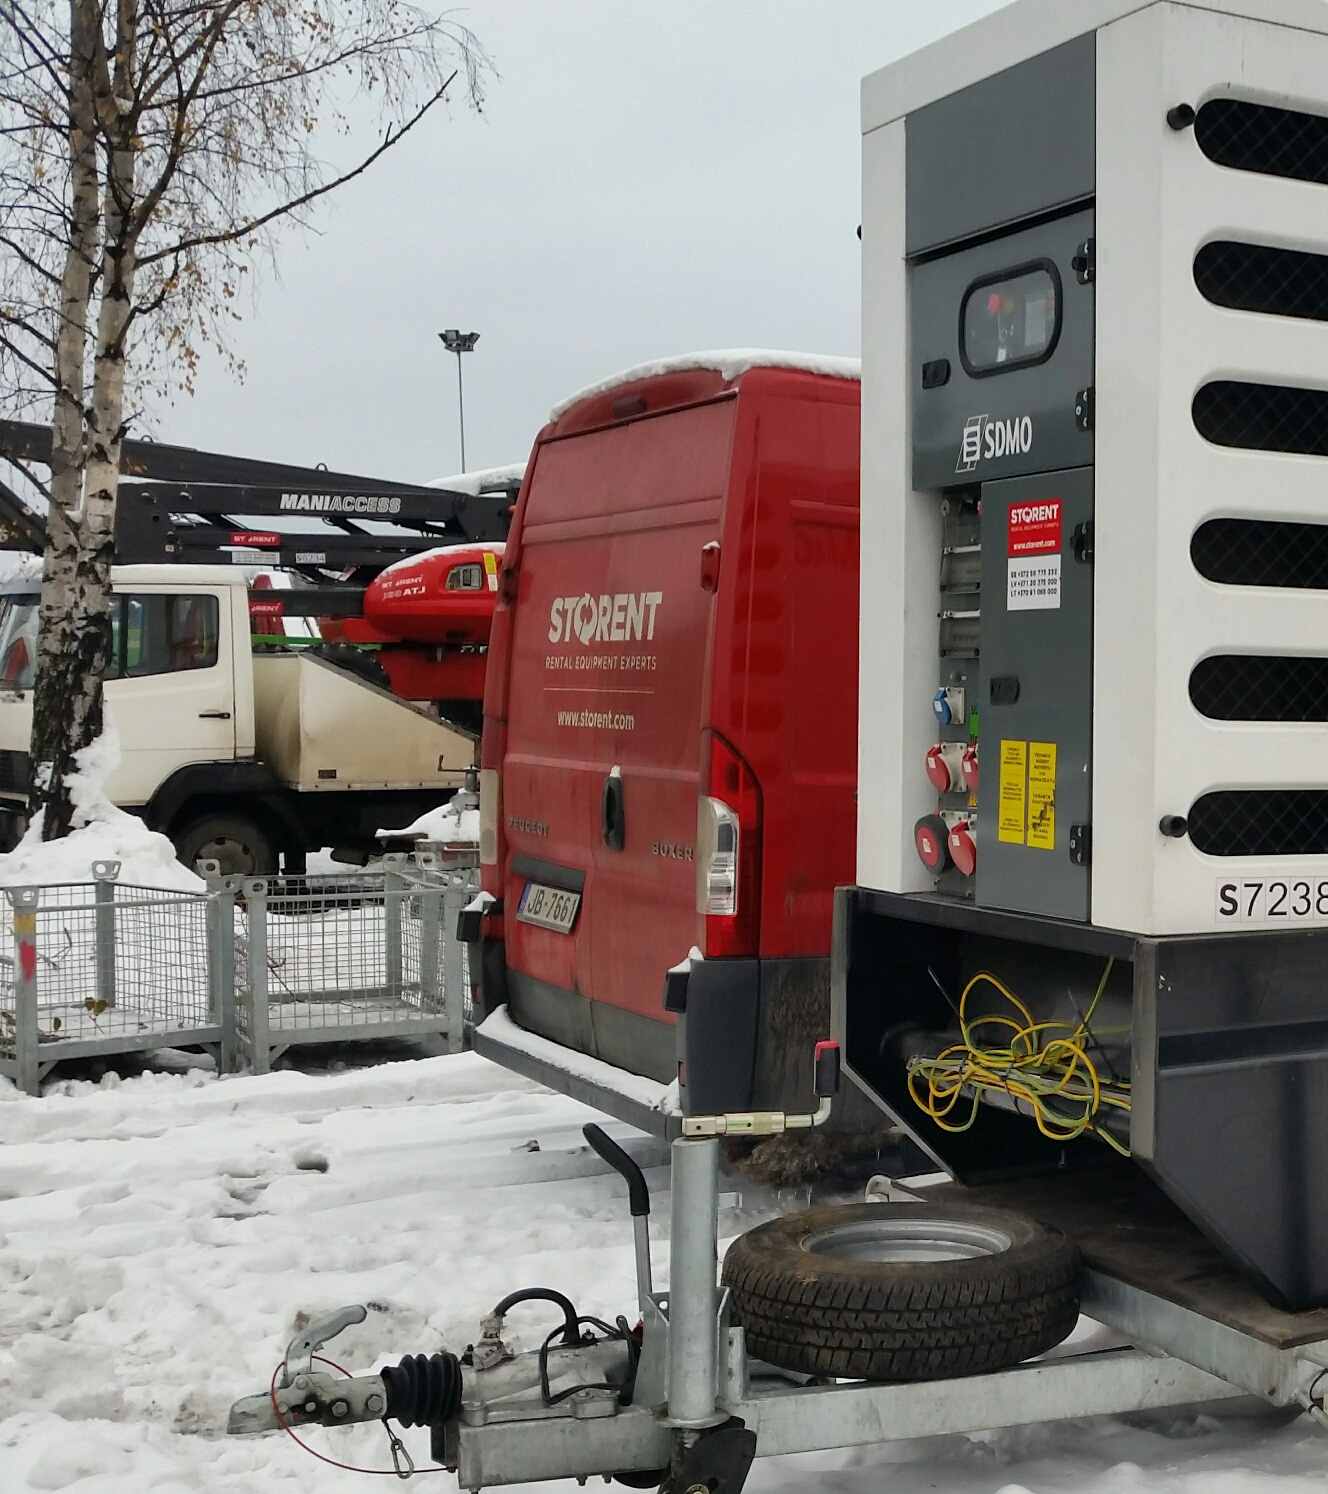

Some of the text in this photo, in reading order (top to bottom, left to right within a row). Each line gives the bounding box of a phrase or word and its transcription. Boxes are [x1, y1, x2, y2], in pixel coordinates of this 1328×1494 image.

[983, 416, 1033, 459] SDMO
[280, 493, 401, 513] MANIACCESS
[1011, 504, 1059, 524] STORENT
[548, 592, 663, 646] STORENT
[545, 656, 656, 670] RENTAL EQUIPMENT EXPERTS
[557, 709, 635, 730] www.storent.com
[508, 817, 548, 837] PEUGEOT
[653, 841, 693, 861] BOXER
